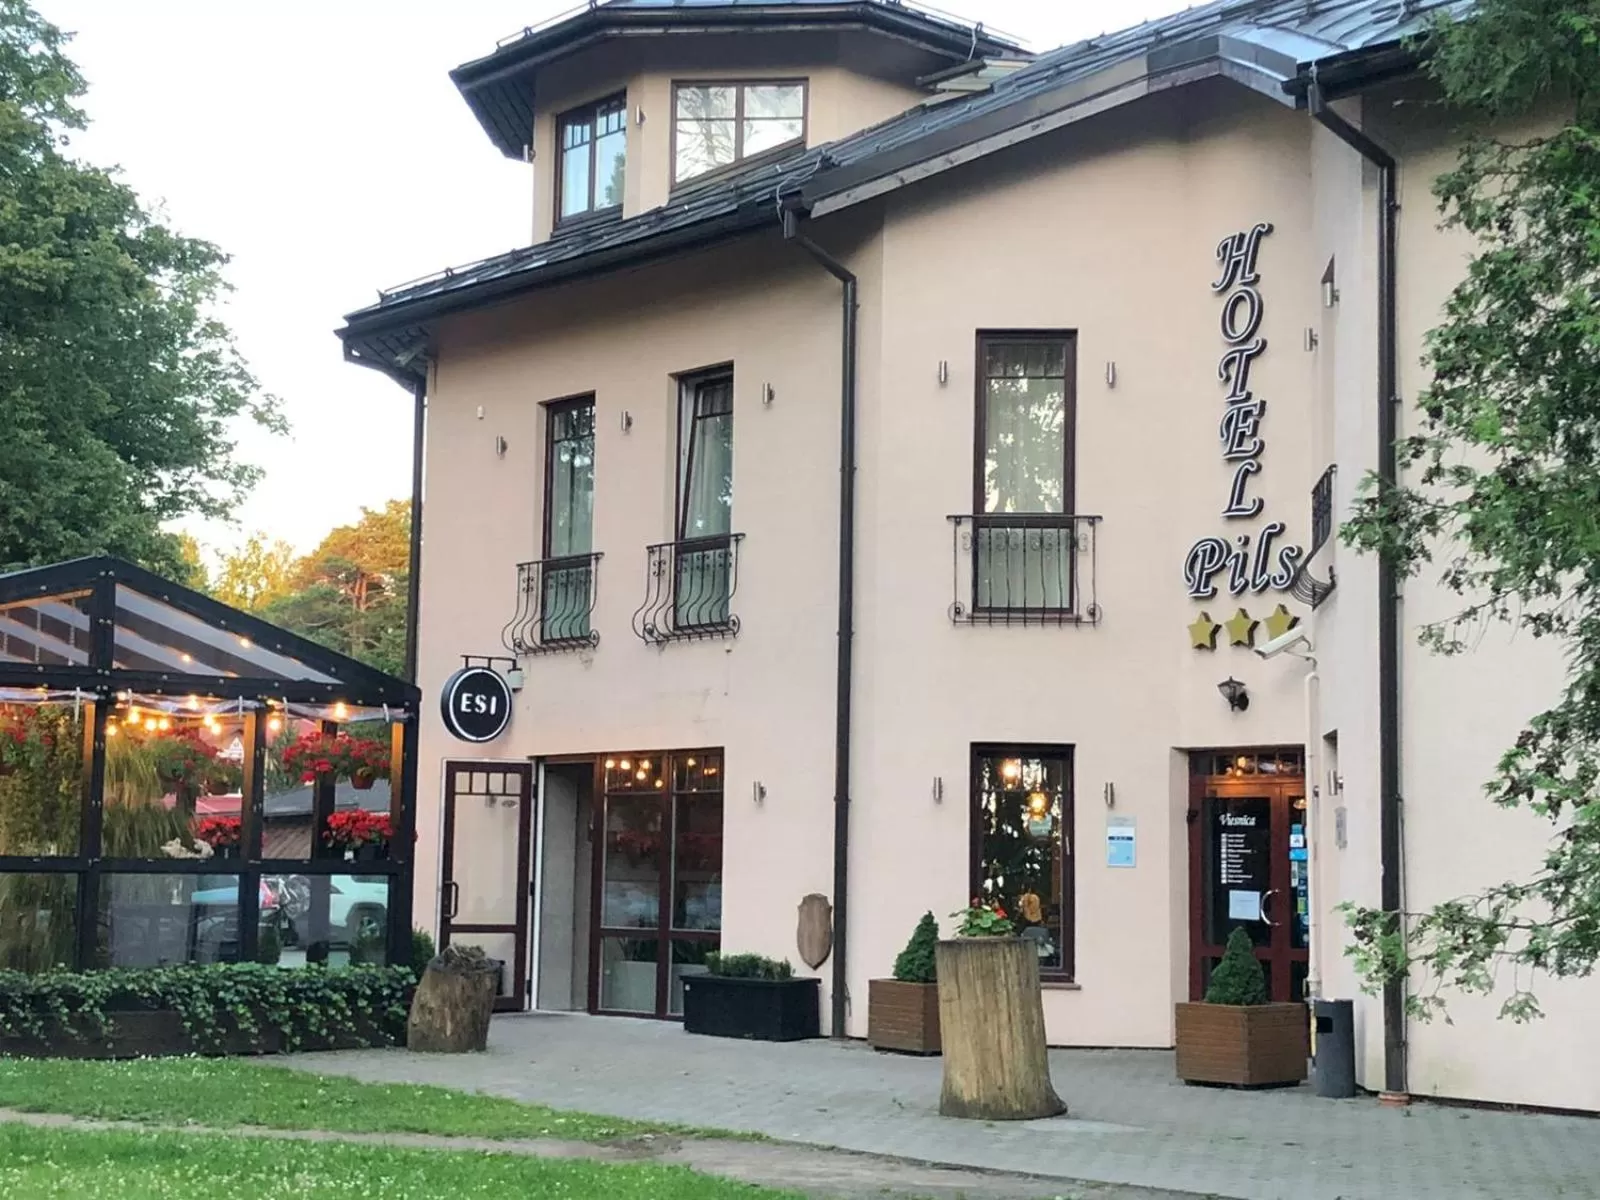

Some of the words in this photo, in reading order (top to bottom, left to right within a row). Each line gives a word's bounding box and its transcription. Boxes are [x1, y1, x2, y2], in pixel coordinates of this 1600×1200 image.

[1211, 222, 1274, 519] HOTEL
[1183, 521, 1303, 600] Pils
[460, 692, 498, 716] ESI
